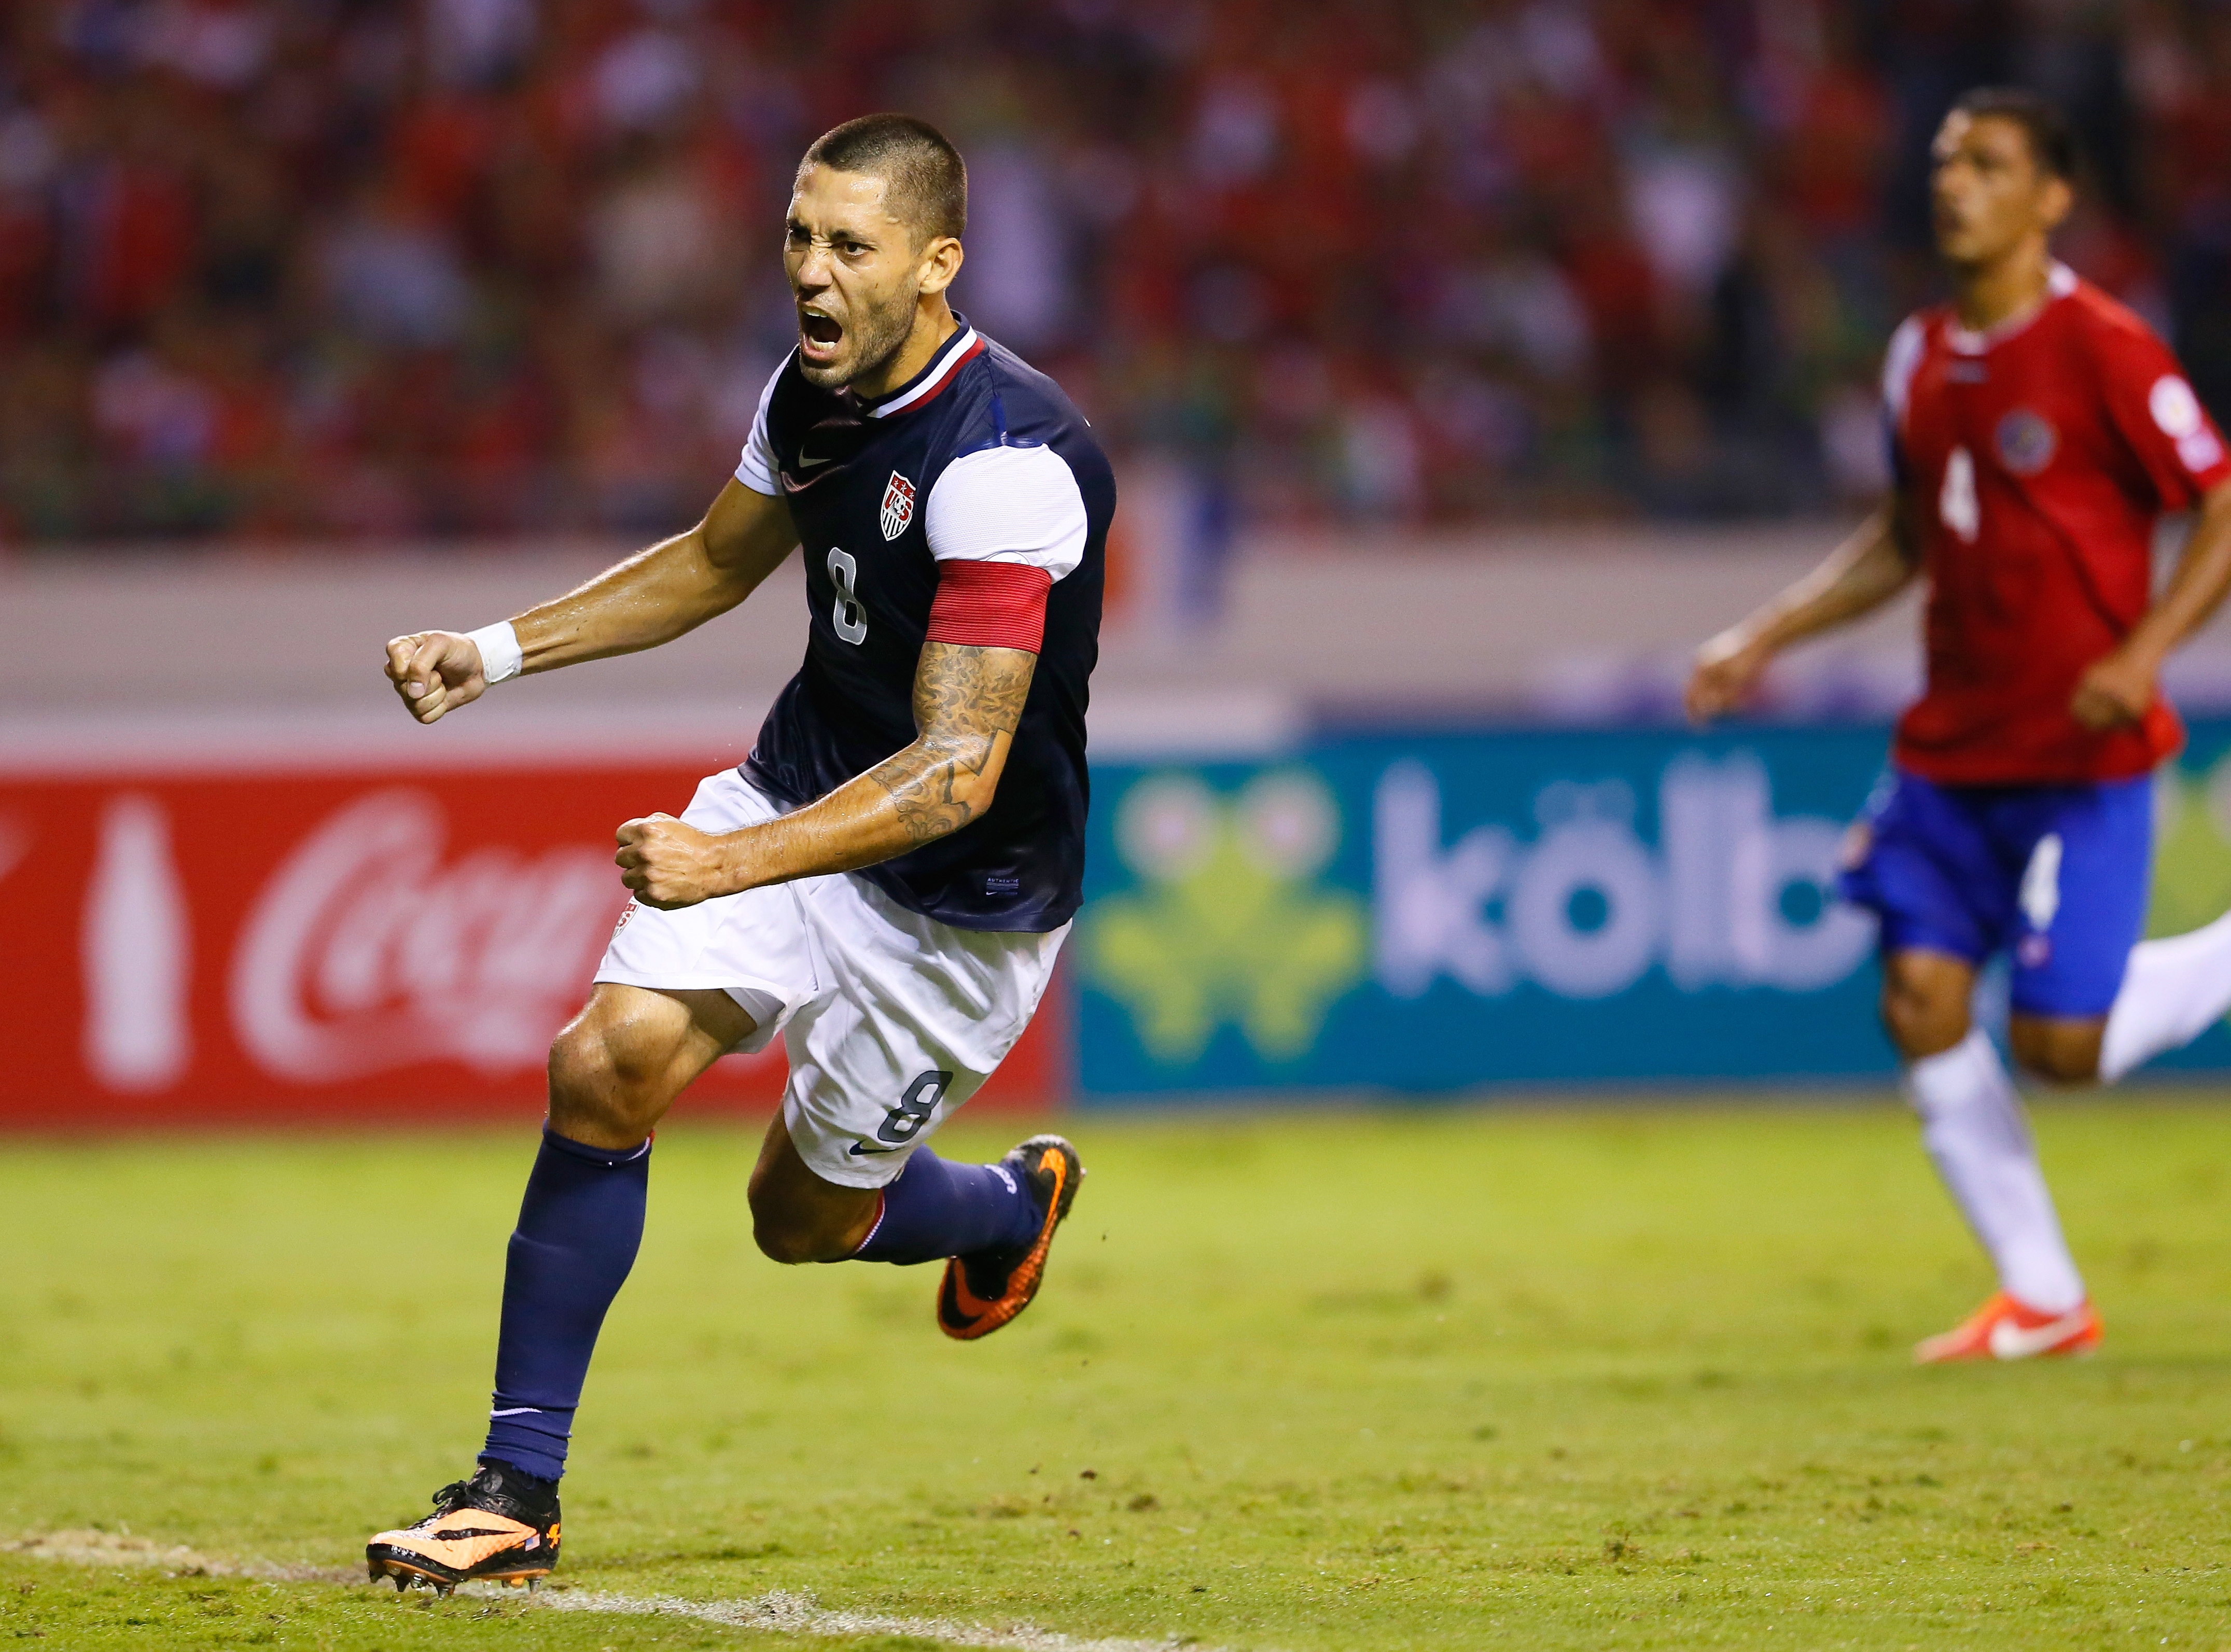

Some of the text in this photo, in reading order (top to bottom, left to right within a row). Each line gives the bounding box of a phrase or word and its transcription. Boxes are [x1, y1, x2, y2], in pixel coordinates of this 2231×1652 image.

[1939, 443, 1982, 545] 4
[828, 547, 867, 646] 8
[2016, 832, 2063, 933] 4
[877, 1070, 953, 1143] 8
